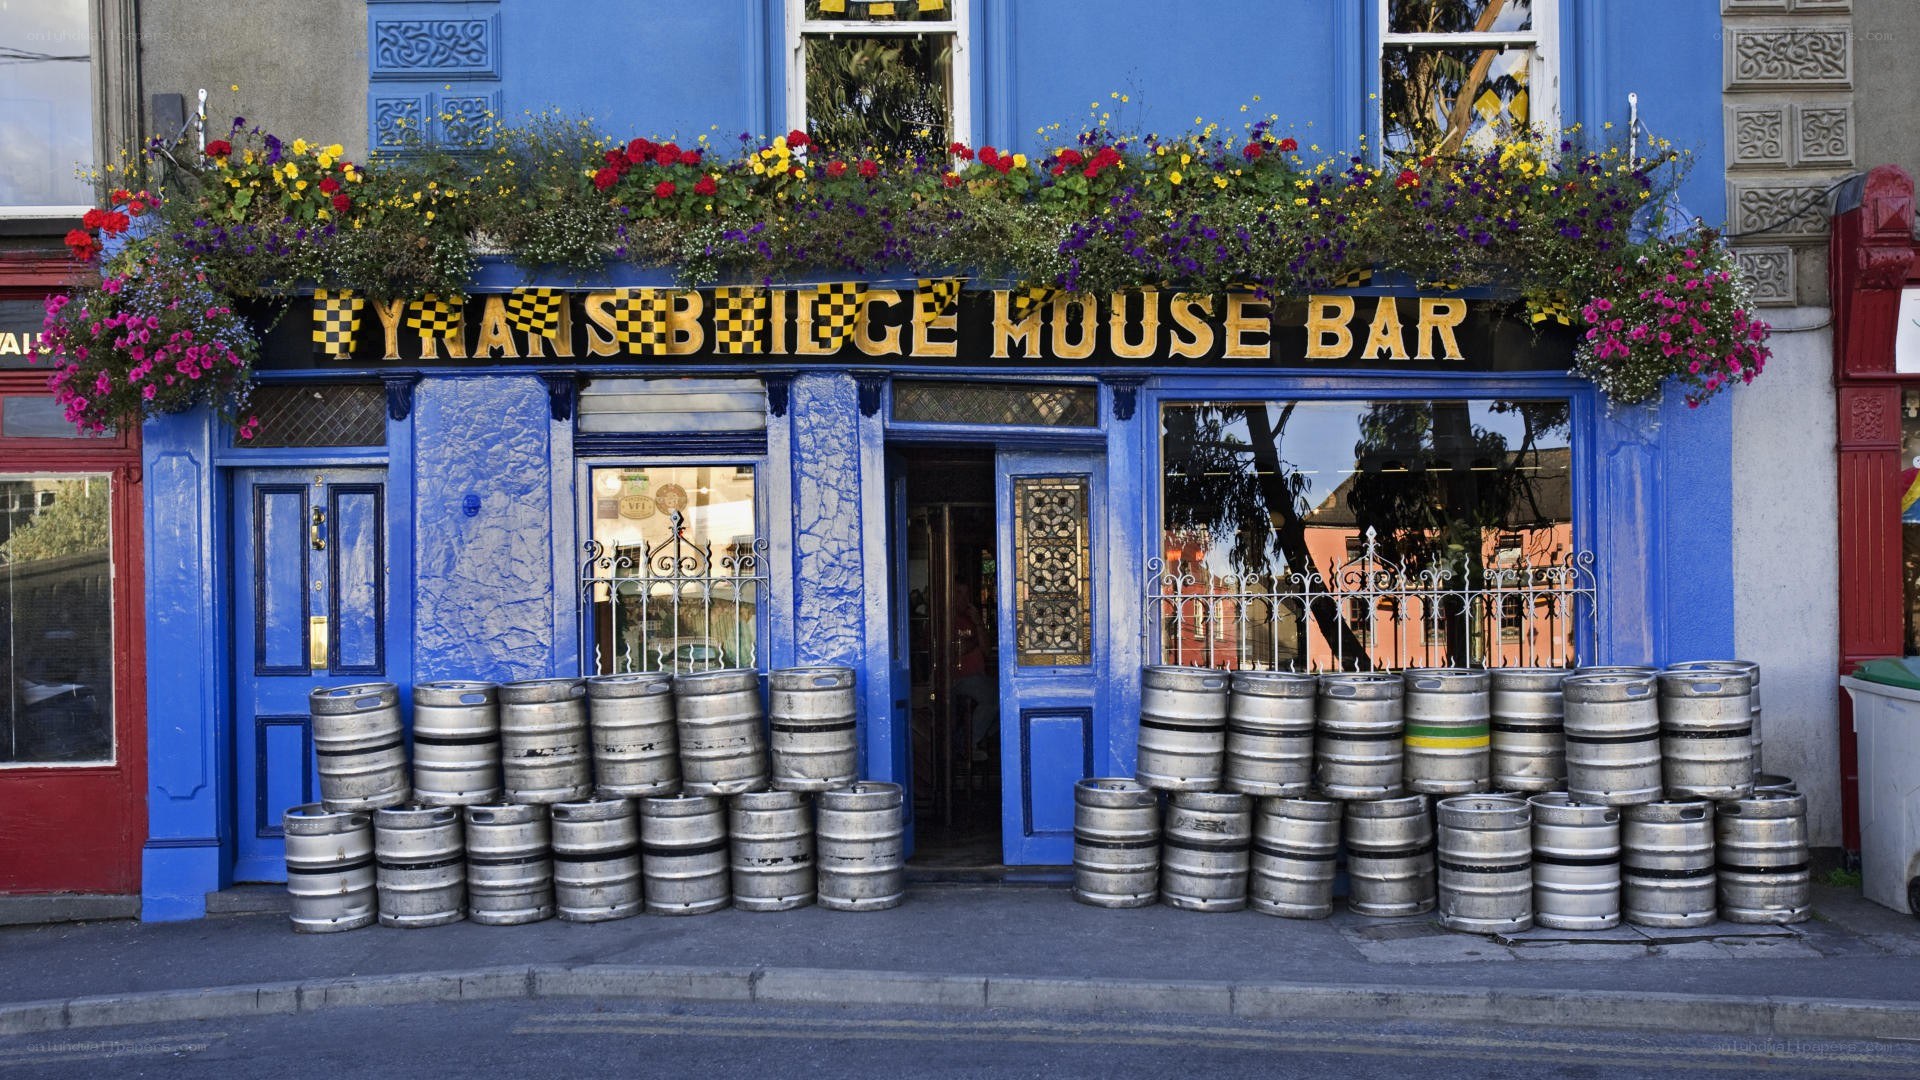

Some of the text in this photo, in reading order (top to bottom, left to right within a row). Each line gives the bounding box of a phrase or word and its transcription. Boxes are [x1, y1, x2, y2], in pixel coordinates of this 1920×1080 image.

[331, 291, 620, 360] YANS
[656, 288, 957, 357] BIDGE
[1304, 295, 1466, 360] BAR
